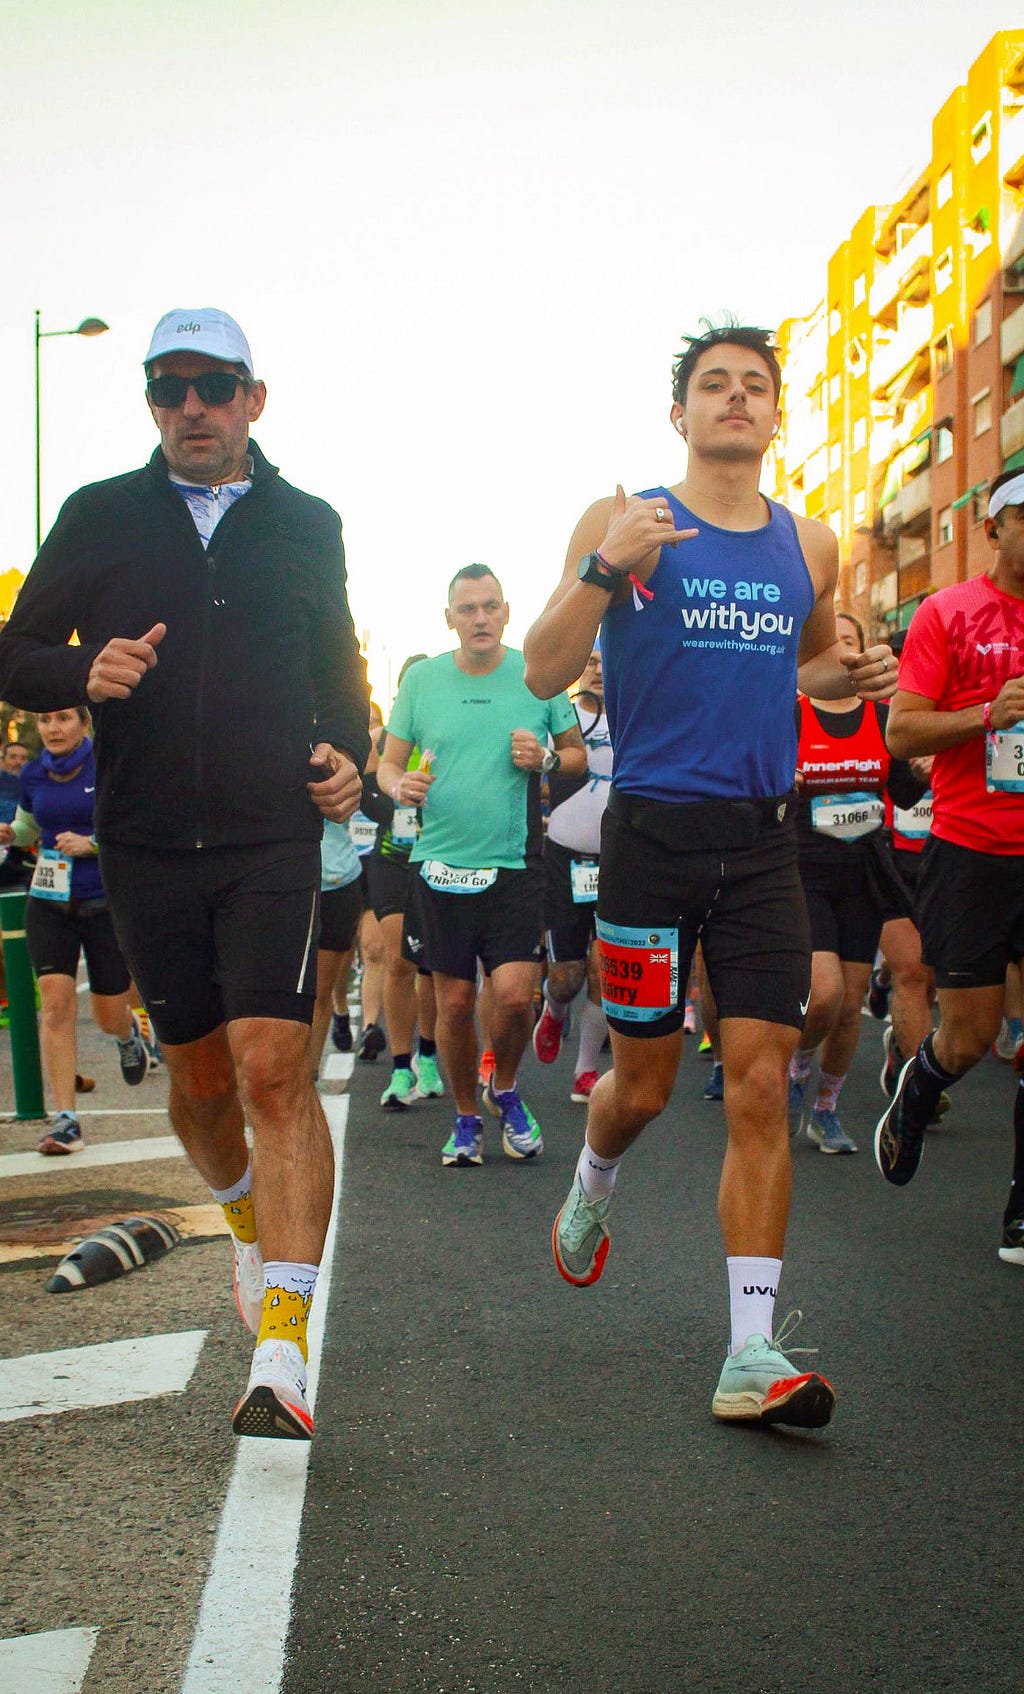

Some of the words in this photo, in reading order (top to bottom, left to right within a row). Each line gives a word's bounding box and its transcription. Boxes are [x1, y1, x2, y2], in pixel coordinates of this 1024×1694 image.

[176, 321, 201, 335] edp
[682, 578, 727, 599] we
[734, 581, 781, 603] are
[681, 601, 794, 641] withyou
[833, 811, 869, 826] 31066
[472, 879, 488, 887] GO
